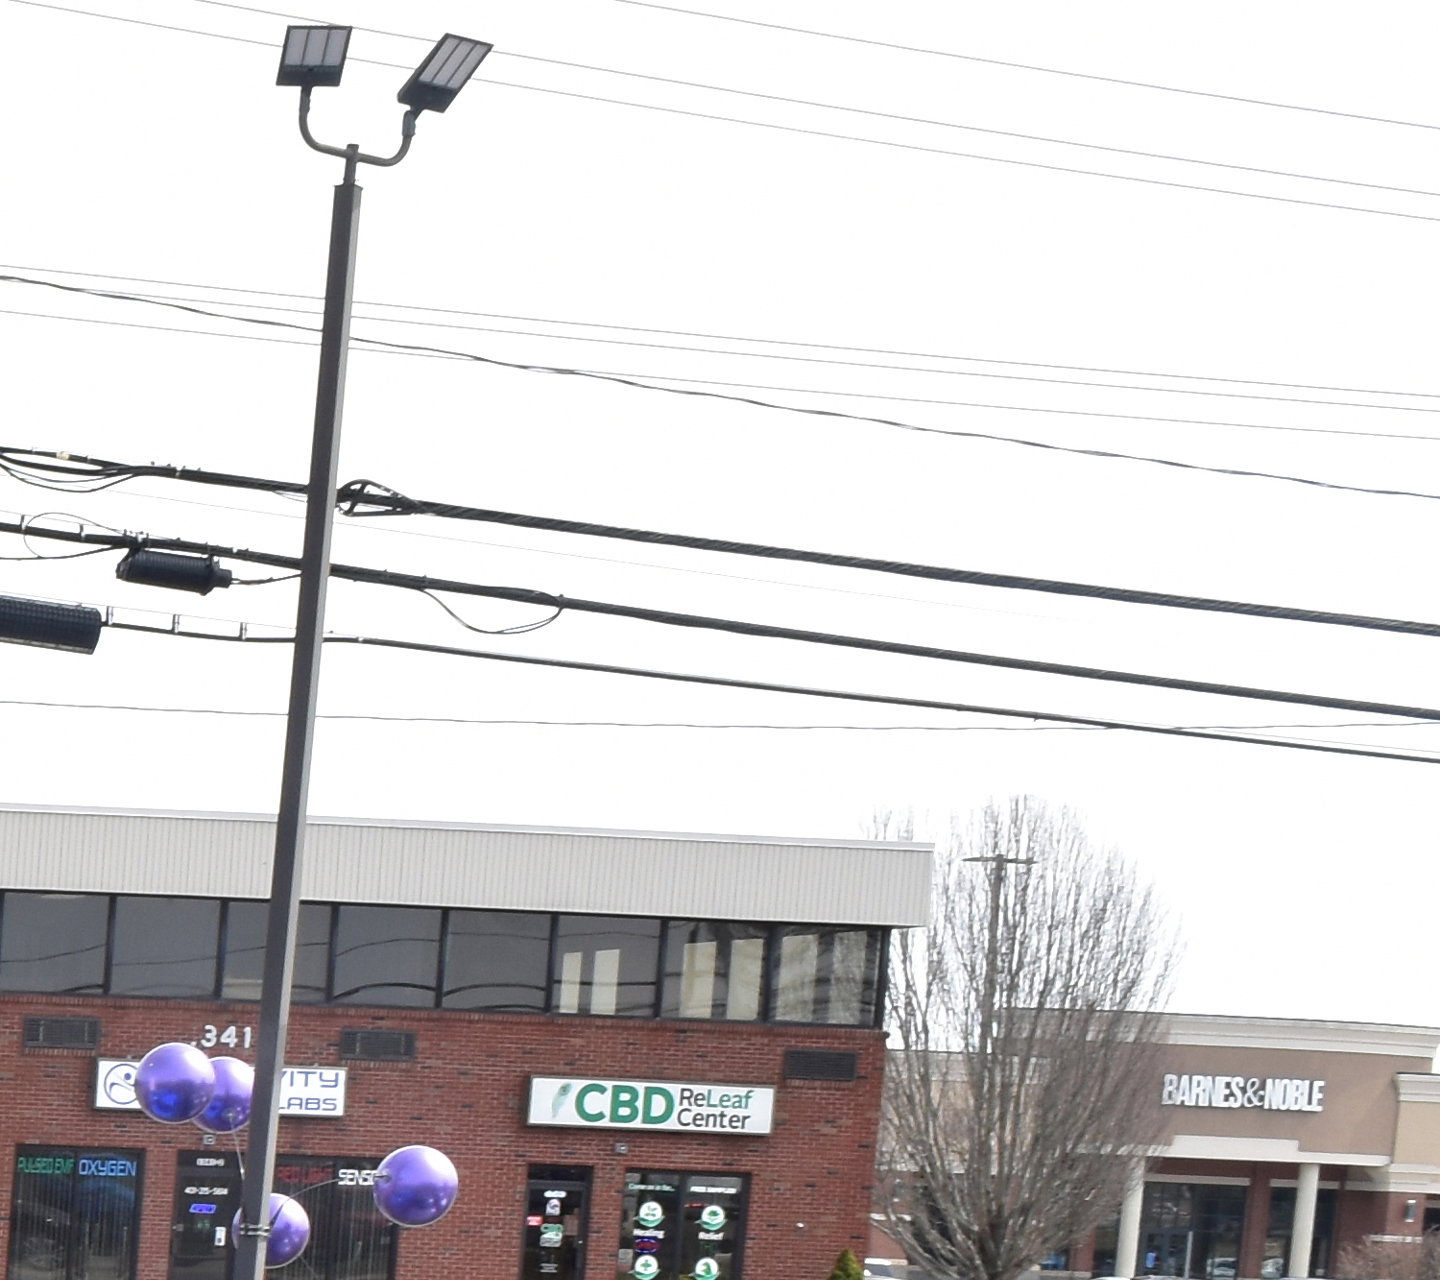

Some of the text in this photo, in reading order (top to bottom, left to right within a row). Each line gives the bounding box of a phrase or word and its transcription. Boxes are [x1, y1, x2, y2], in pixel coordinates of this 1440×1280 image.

[190, 1024, 252, 1048] 341
[575, 1083, 754, 1124] CBD ReLeaf
[677, 1108, 751, 1129] Center
[79, 1159, 136, 1176] OXYGEN
